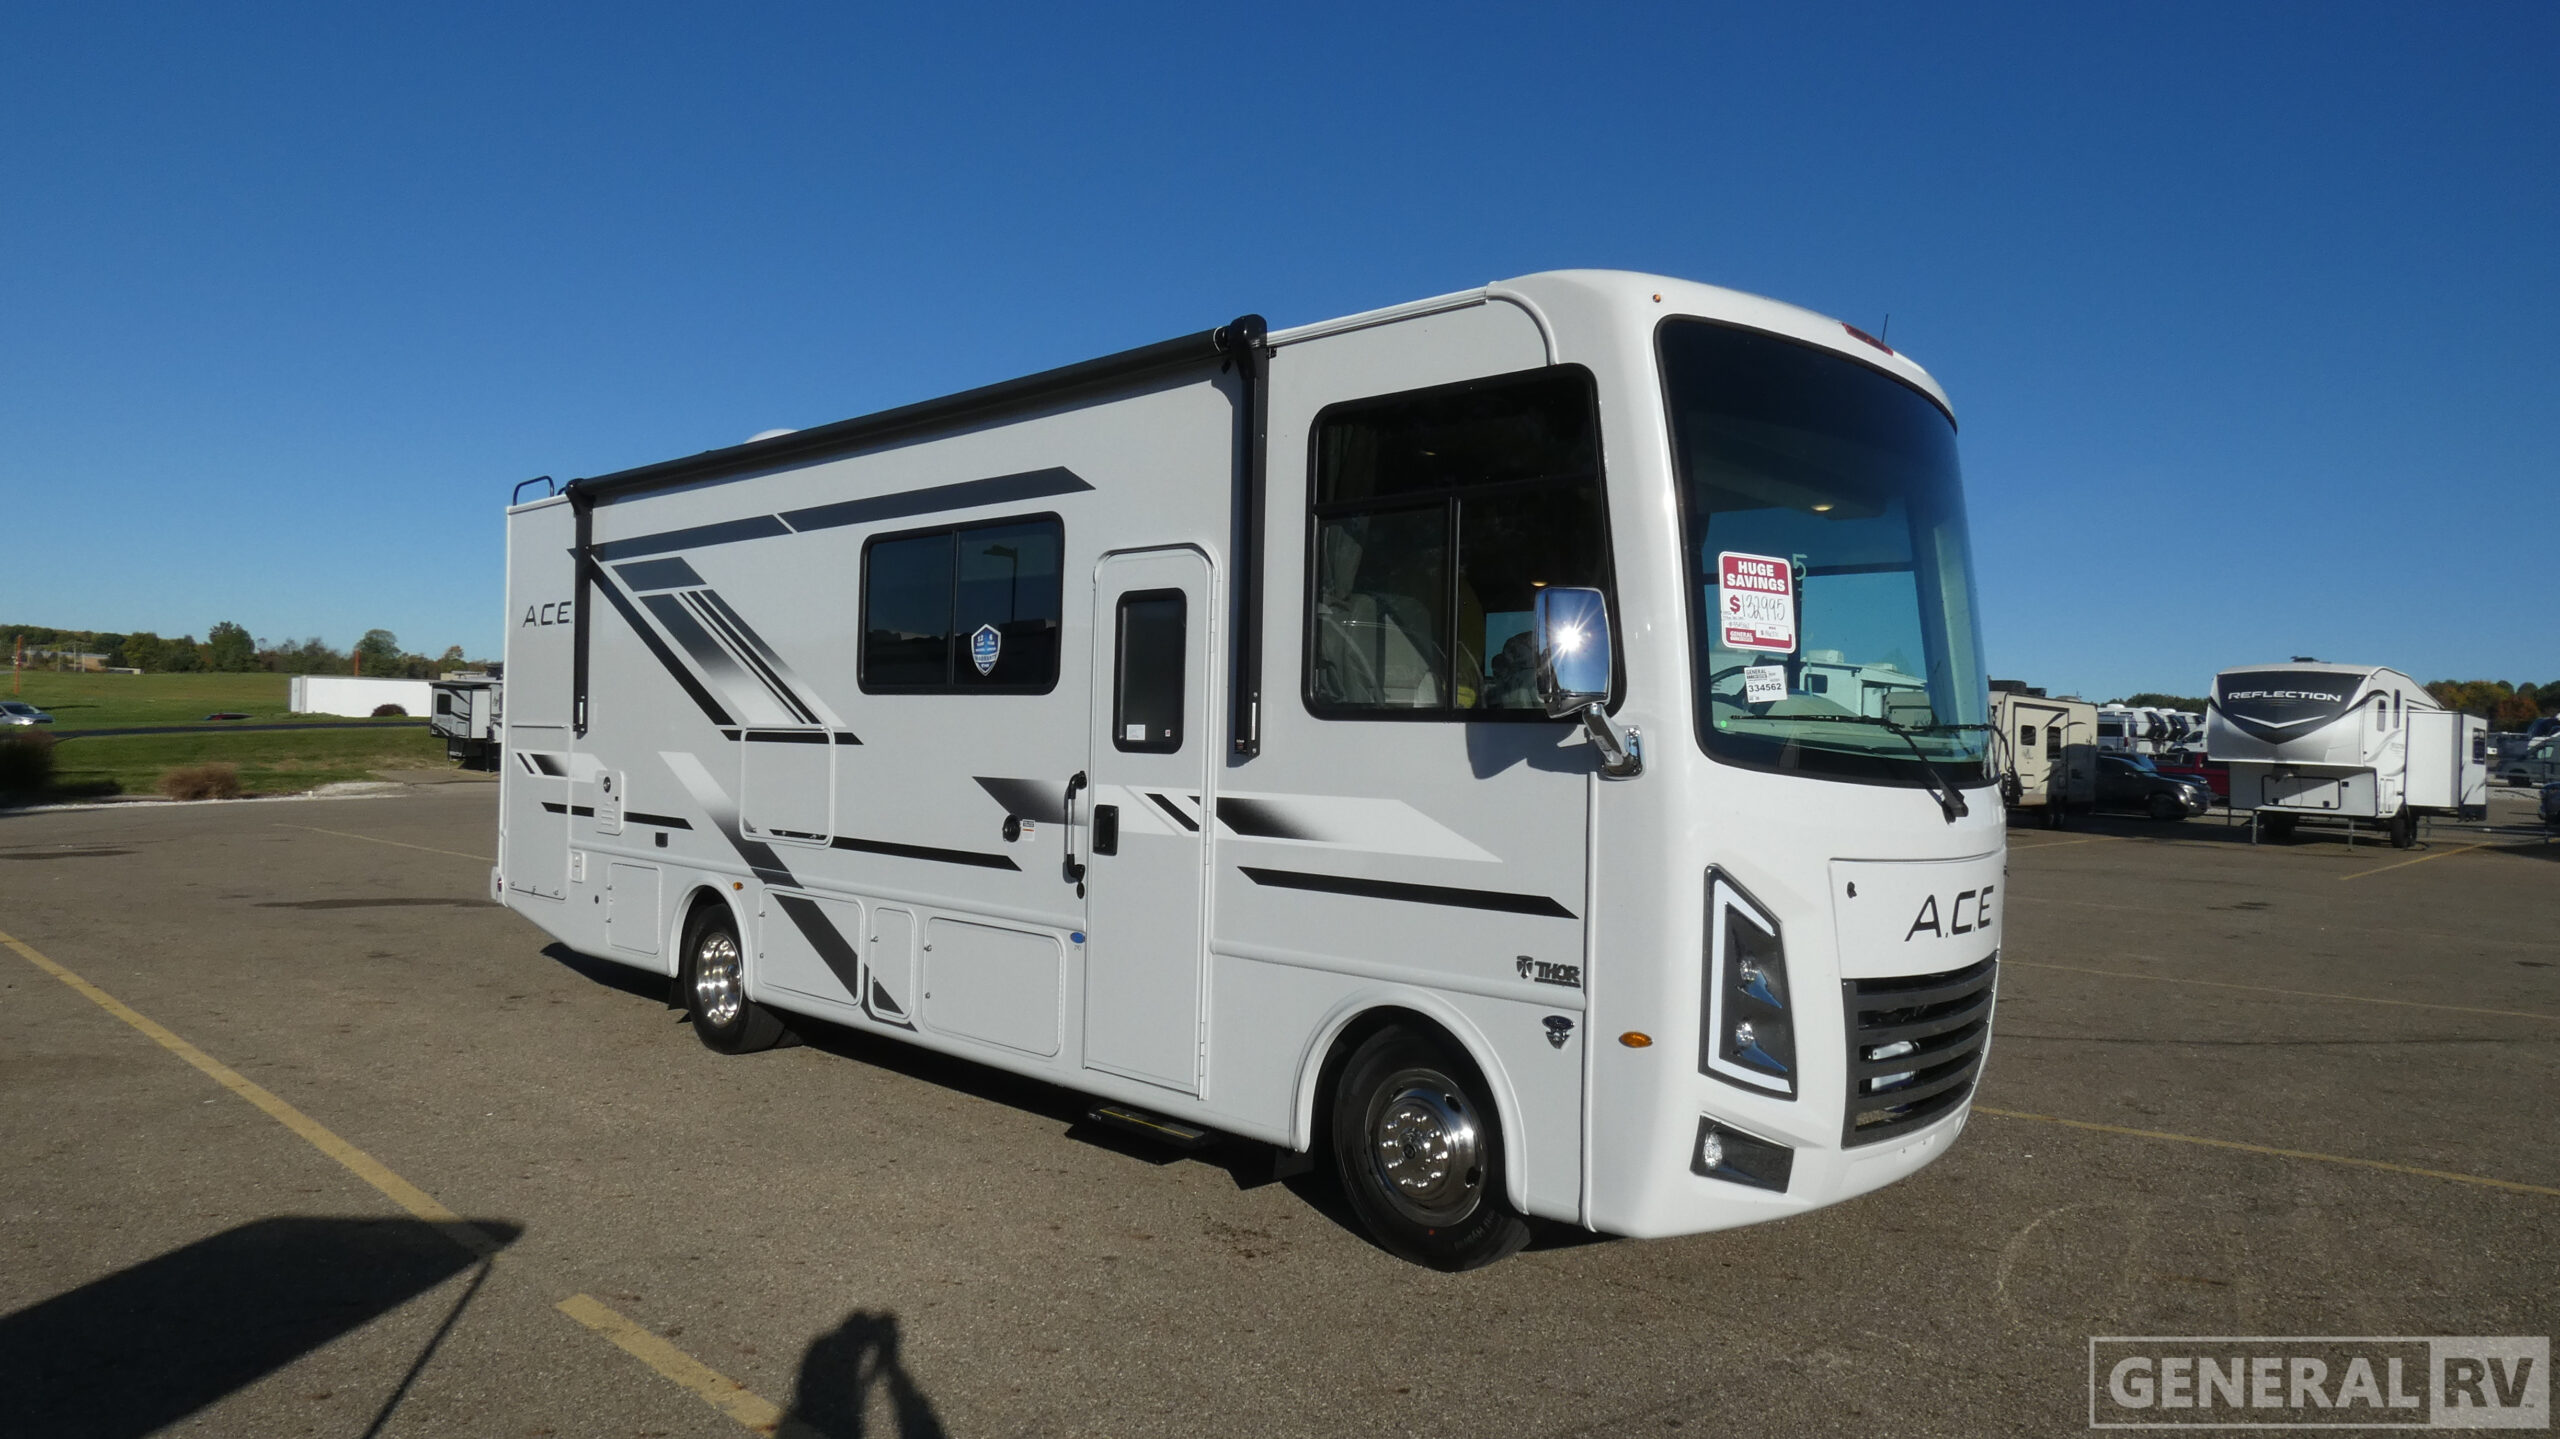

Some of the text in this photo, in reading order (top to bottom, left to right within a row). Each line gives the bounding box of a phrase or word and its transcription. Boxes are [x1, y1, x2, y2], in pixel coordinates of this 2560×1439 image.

[1738, 560, 1775, 577] HUGE
[1726, 573, 1786, 592] SAVINGS
[1748, 683, 1782, 692] 334562
[2228, 690, 2342, 703] REFLECTION
[1534, 961, 1581, 983] THOR
